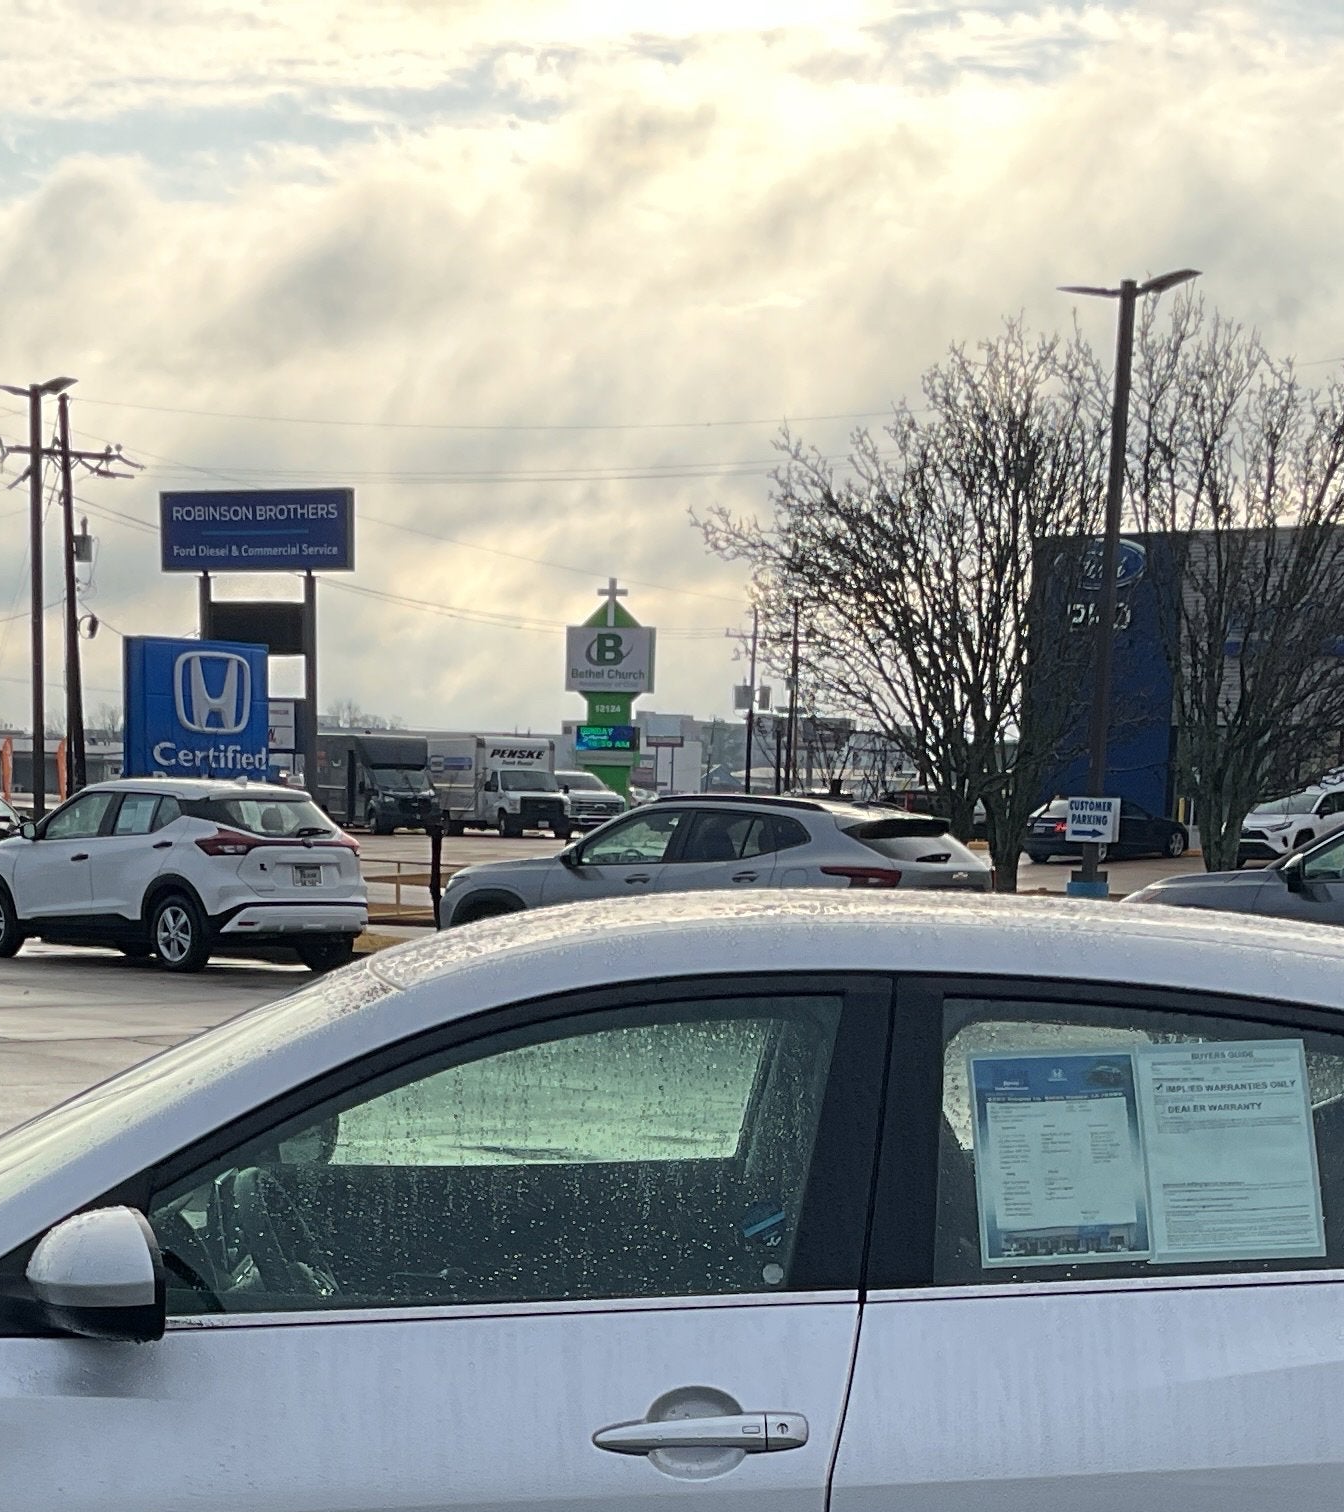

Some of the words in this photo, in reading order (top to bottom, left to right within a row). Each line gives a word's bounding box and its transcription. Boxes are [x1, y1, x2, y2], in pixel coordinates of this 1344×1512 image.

[172, 505, 253, 522] ROBINSON
[256, 503, 338, 521] BROTHERS
[173, 545, 197, 557] Ford
[198, 544, 229, 557] Diesel
[231, 545, 239, 557] &
[241, 543, 300, 557] Commercial
[302, 543, 338, 556] Service
[571, 668, 604, 680] Bethel
[607, 669, 645, 680] Church
[153, 741, 267, 770] Certified
[490, 748, 545, 760] PENSKE
[1069, 800, 1113, 812] CUSTOMER
[1071, 813, 1108, 826] PARKING
[1191, 1051, 1226, 1060] BUYERS
[1205, 1082, 1267, 1092] WARRANTIES
[1269, 1079, 1296, 1089] ONLY
[1167, 1102, 1206, 1114] DEALER
[1208, 1102, 1262, 1112] WARRANTY
